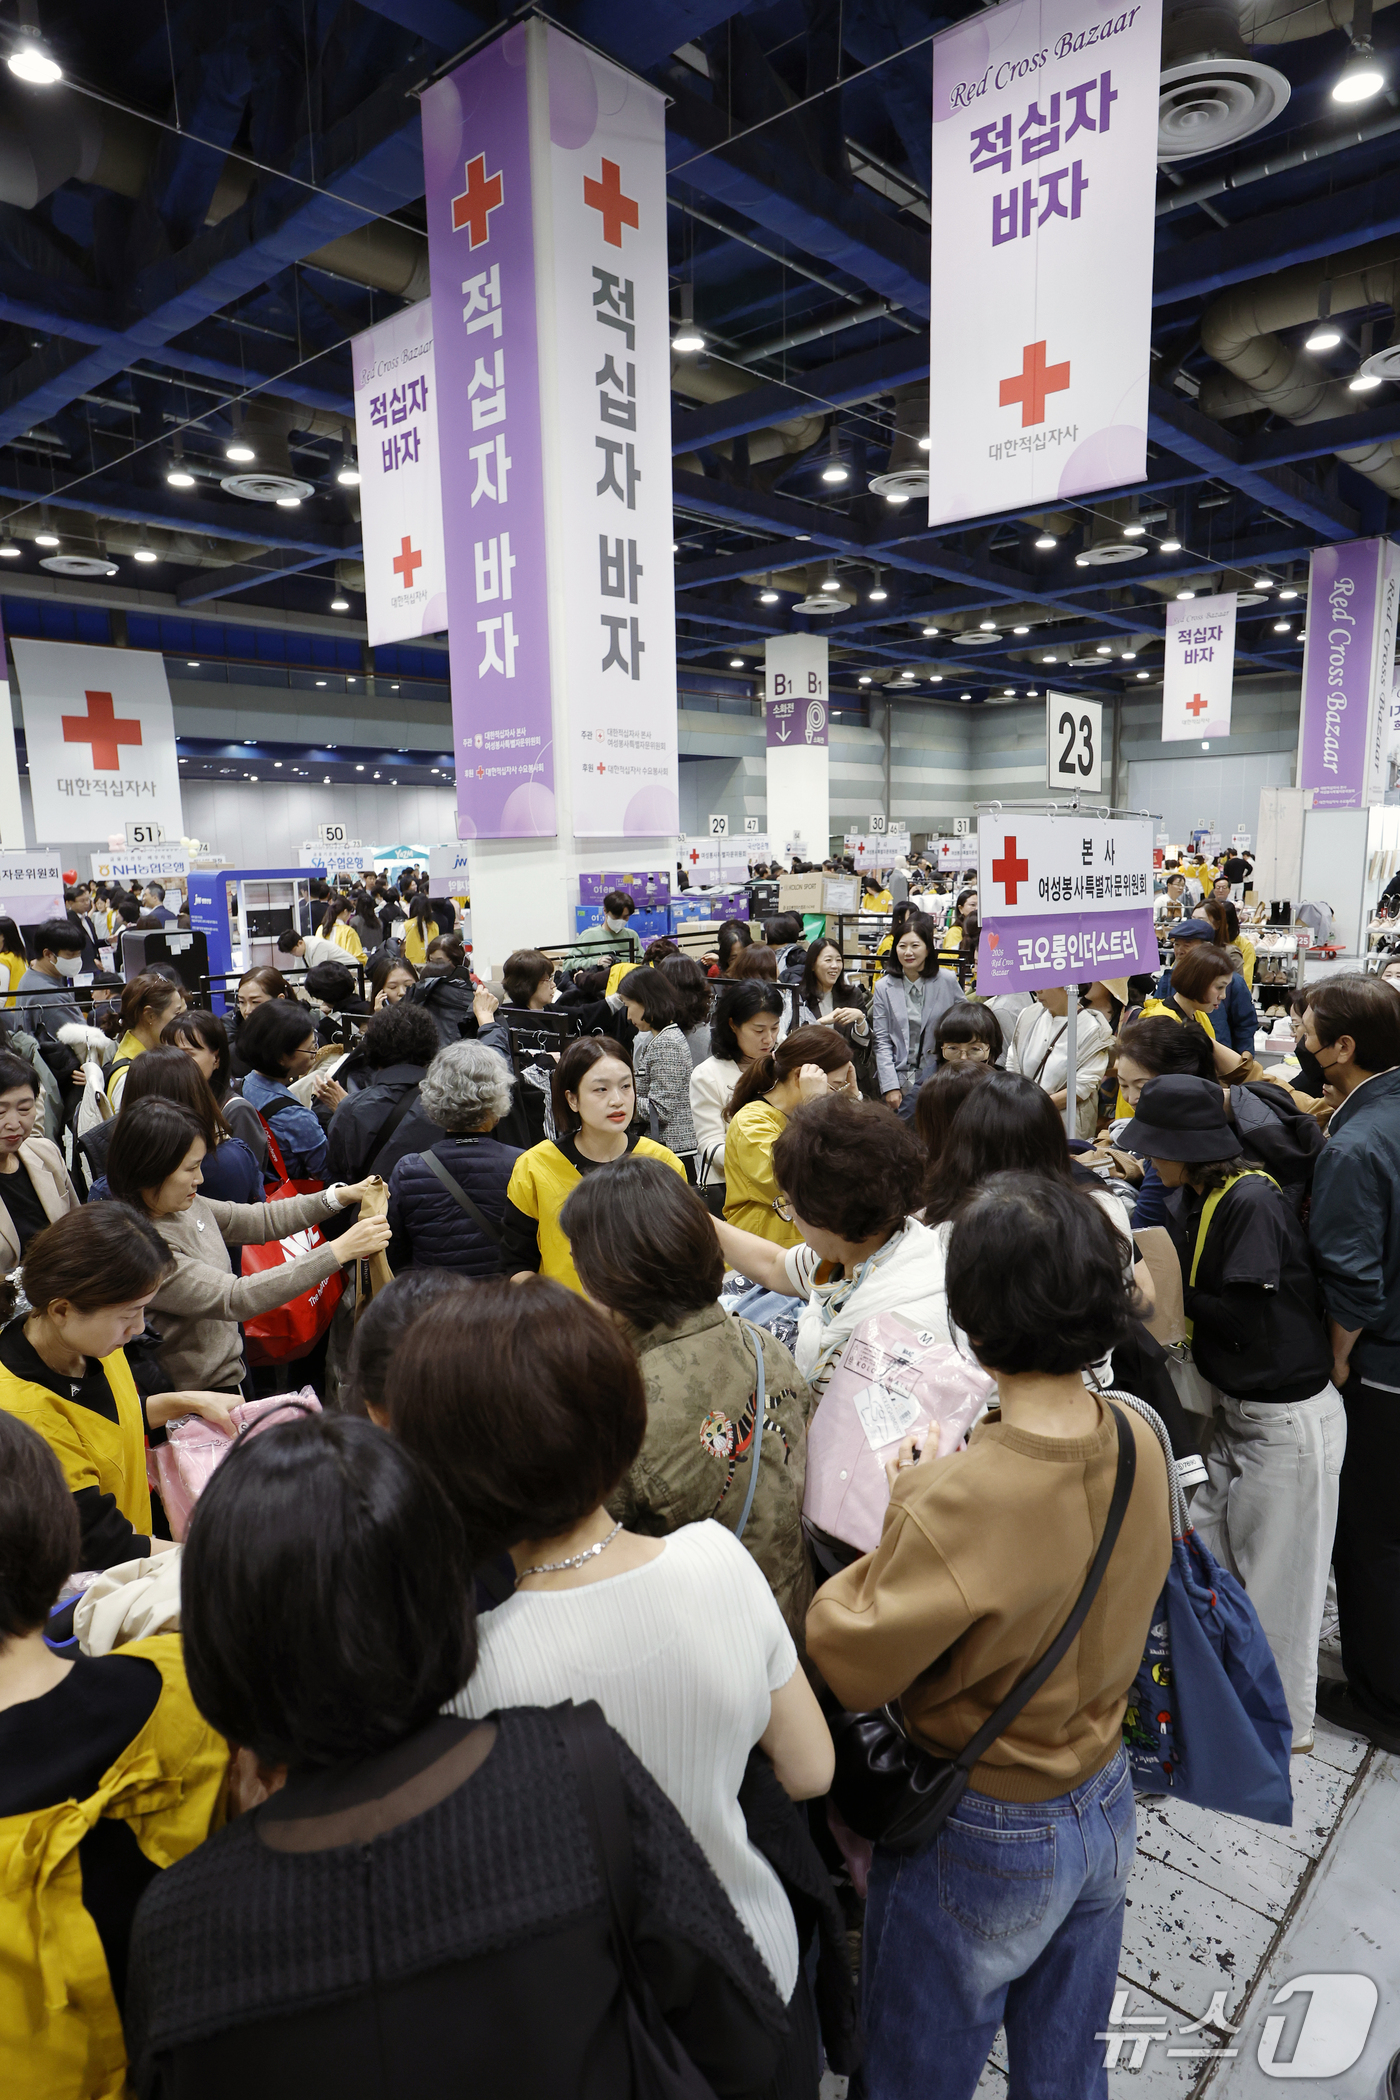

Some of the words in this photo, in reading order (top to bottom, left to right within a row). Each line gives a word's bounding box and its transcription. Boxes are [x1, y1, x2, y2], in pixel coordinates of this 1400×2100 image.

[951, 65, 994, 108] Red
[994, 48, 1049, 91] Cross
[1053, 5, 1142, 60] Bazaar
[970, 70, 1119, 175] 적십자
[992, 159, 1089, 248] 바자
[359, 361, 377, 385] Red
[377, 356, 400, 379] Cross
[400, 339, 434, 365] Bazaar
[461, 263, 512, 509] 적십자
[592, 265, 641, 511] 적십자
[369, 374, 429, 430] 적십자
[381, 427, 421, 473] 바자
[989, 424, 1079, 461] 대한적십자사
[473, 531, 519, 680] 바자
[599, 533, 646, 681] 바자
[1329, 578, 1356, 626] Red
[1386, 578, 1395, 622] Red
[1178, 625, 1224, 645] 적십자
[1184, 646, 1214, 664] 바자
[1328, 629, 1352, 688] Cross
[1380, 624, 1391, 688] Cross
[774, 673, 792, 696] B1
[808, 671, 822, 695] B1
[772, 702, 795, 714] 소화전
[462, 738, 473, 747] 주관
[484, 729, 516, 740] 대한적십자사
[516, 727, 527, 737] 본사
[485, 736, 541, 751] 여성봉사특별자문위원회
[581, 731, 593, 741] 주관
[607, 728, 640, 740] 대한적십자사
[641, 730, 652, 740] 본사
[607, 738, 666, 751] 여성봉사특별자문위원회
[1058, 711, 1094, 776] 23
[1323, 692, 1348, 775] Bazaar
[1374, 692, 1386, 775] Bazaar
[485, 766, 517, 777] 대한적십자사
[582, 763, 594, 773] 후원
[607, 766, 641, 776] 대한적십자사
[641, 766, 669, 776] 수요봉사회
[57, 778, 156, 797] 대한적십자사
[133, 827, 153, 842] 51
[326, 827, 344, 841] 50
[712, 818, 726, 833] 29
[747, 820, 757, 830] 47
[872, 817, 884, 830] 30
[957, 821, 967, 832] 31
[0, 867, 59, 880] 자문위원회
[113, 861, 185, 876] NH농협은행
[311, 857, 325, 868] Sh
[327, 857, 364, 870] 수협은행
[1038, 873, 1147, 902] 여성봉사특별자문위원회
[1017, 927, 1139, 972] 코오롱인더스트리
[919, 1332, 933, 1345] M
